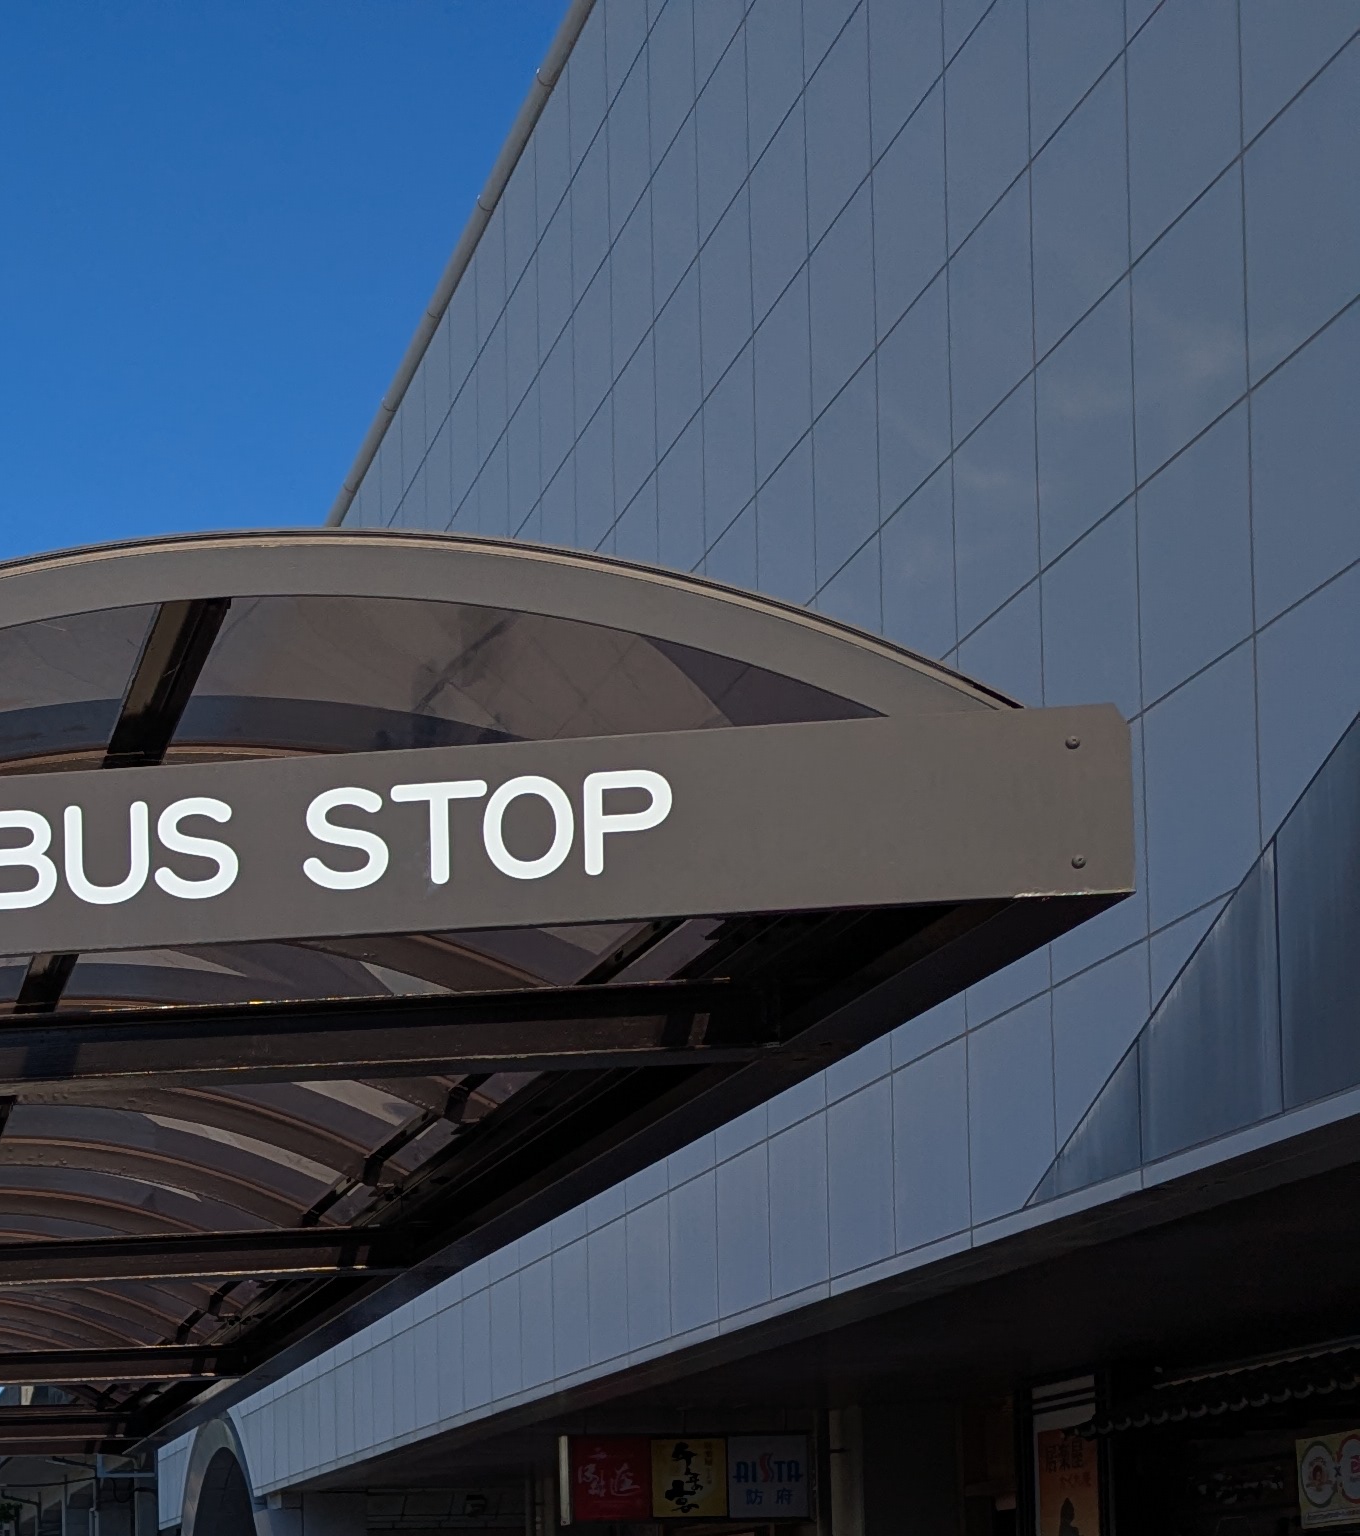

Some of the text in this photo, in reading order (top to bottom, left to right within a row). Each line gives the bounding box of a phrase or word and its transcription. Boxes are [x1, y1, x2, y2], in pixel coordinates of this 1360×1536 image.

[303, 768, 673, 890] STOP
[732, 1452, 804, 1484] AISTA
[745, 1488, 793, 1506] 防府
